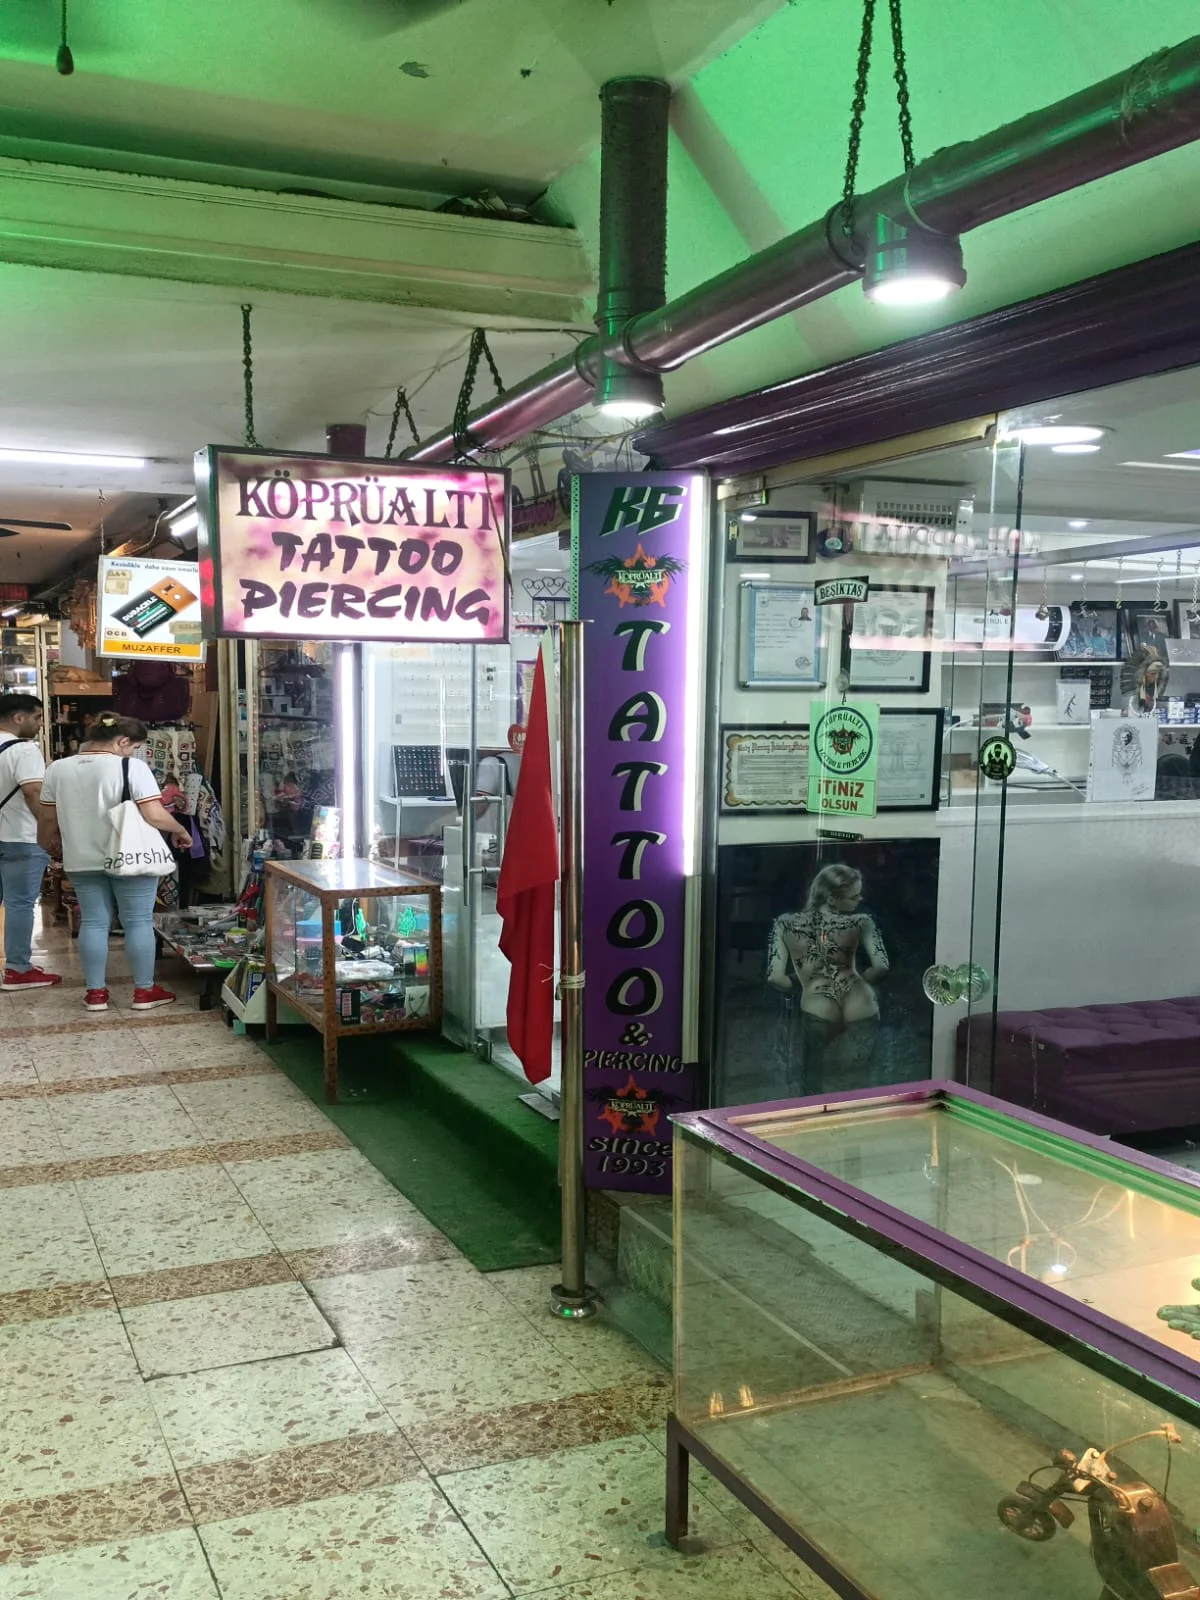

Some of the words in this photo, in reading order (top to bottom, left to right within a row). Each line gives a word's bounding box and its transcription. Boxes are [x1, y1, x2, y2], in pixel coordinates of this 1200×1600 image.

[235, 469, 493, 531] KÖPRÜALTI
[271, 531, 463, 576] TATTOO
[239, 578, 491, 625] PIERCING
[122, 643, 181, 654] MUZAFFER
[822, 798, 858, 812] OLSUN
[605, 619, 671, 1017] TATTOO
[619, 1022, 653, 1047] &
[583, 1049, 685, 1074] PIERCING
[598, 1155, 667, 1178] 1993
